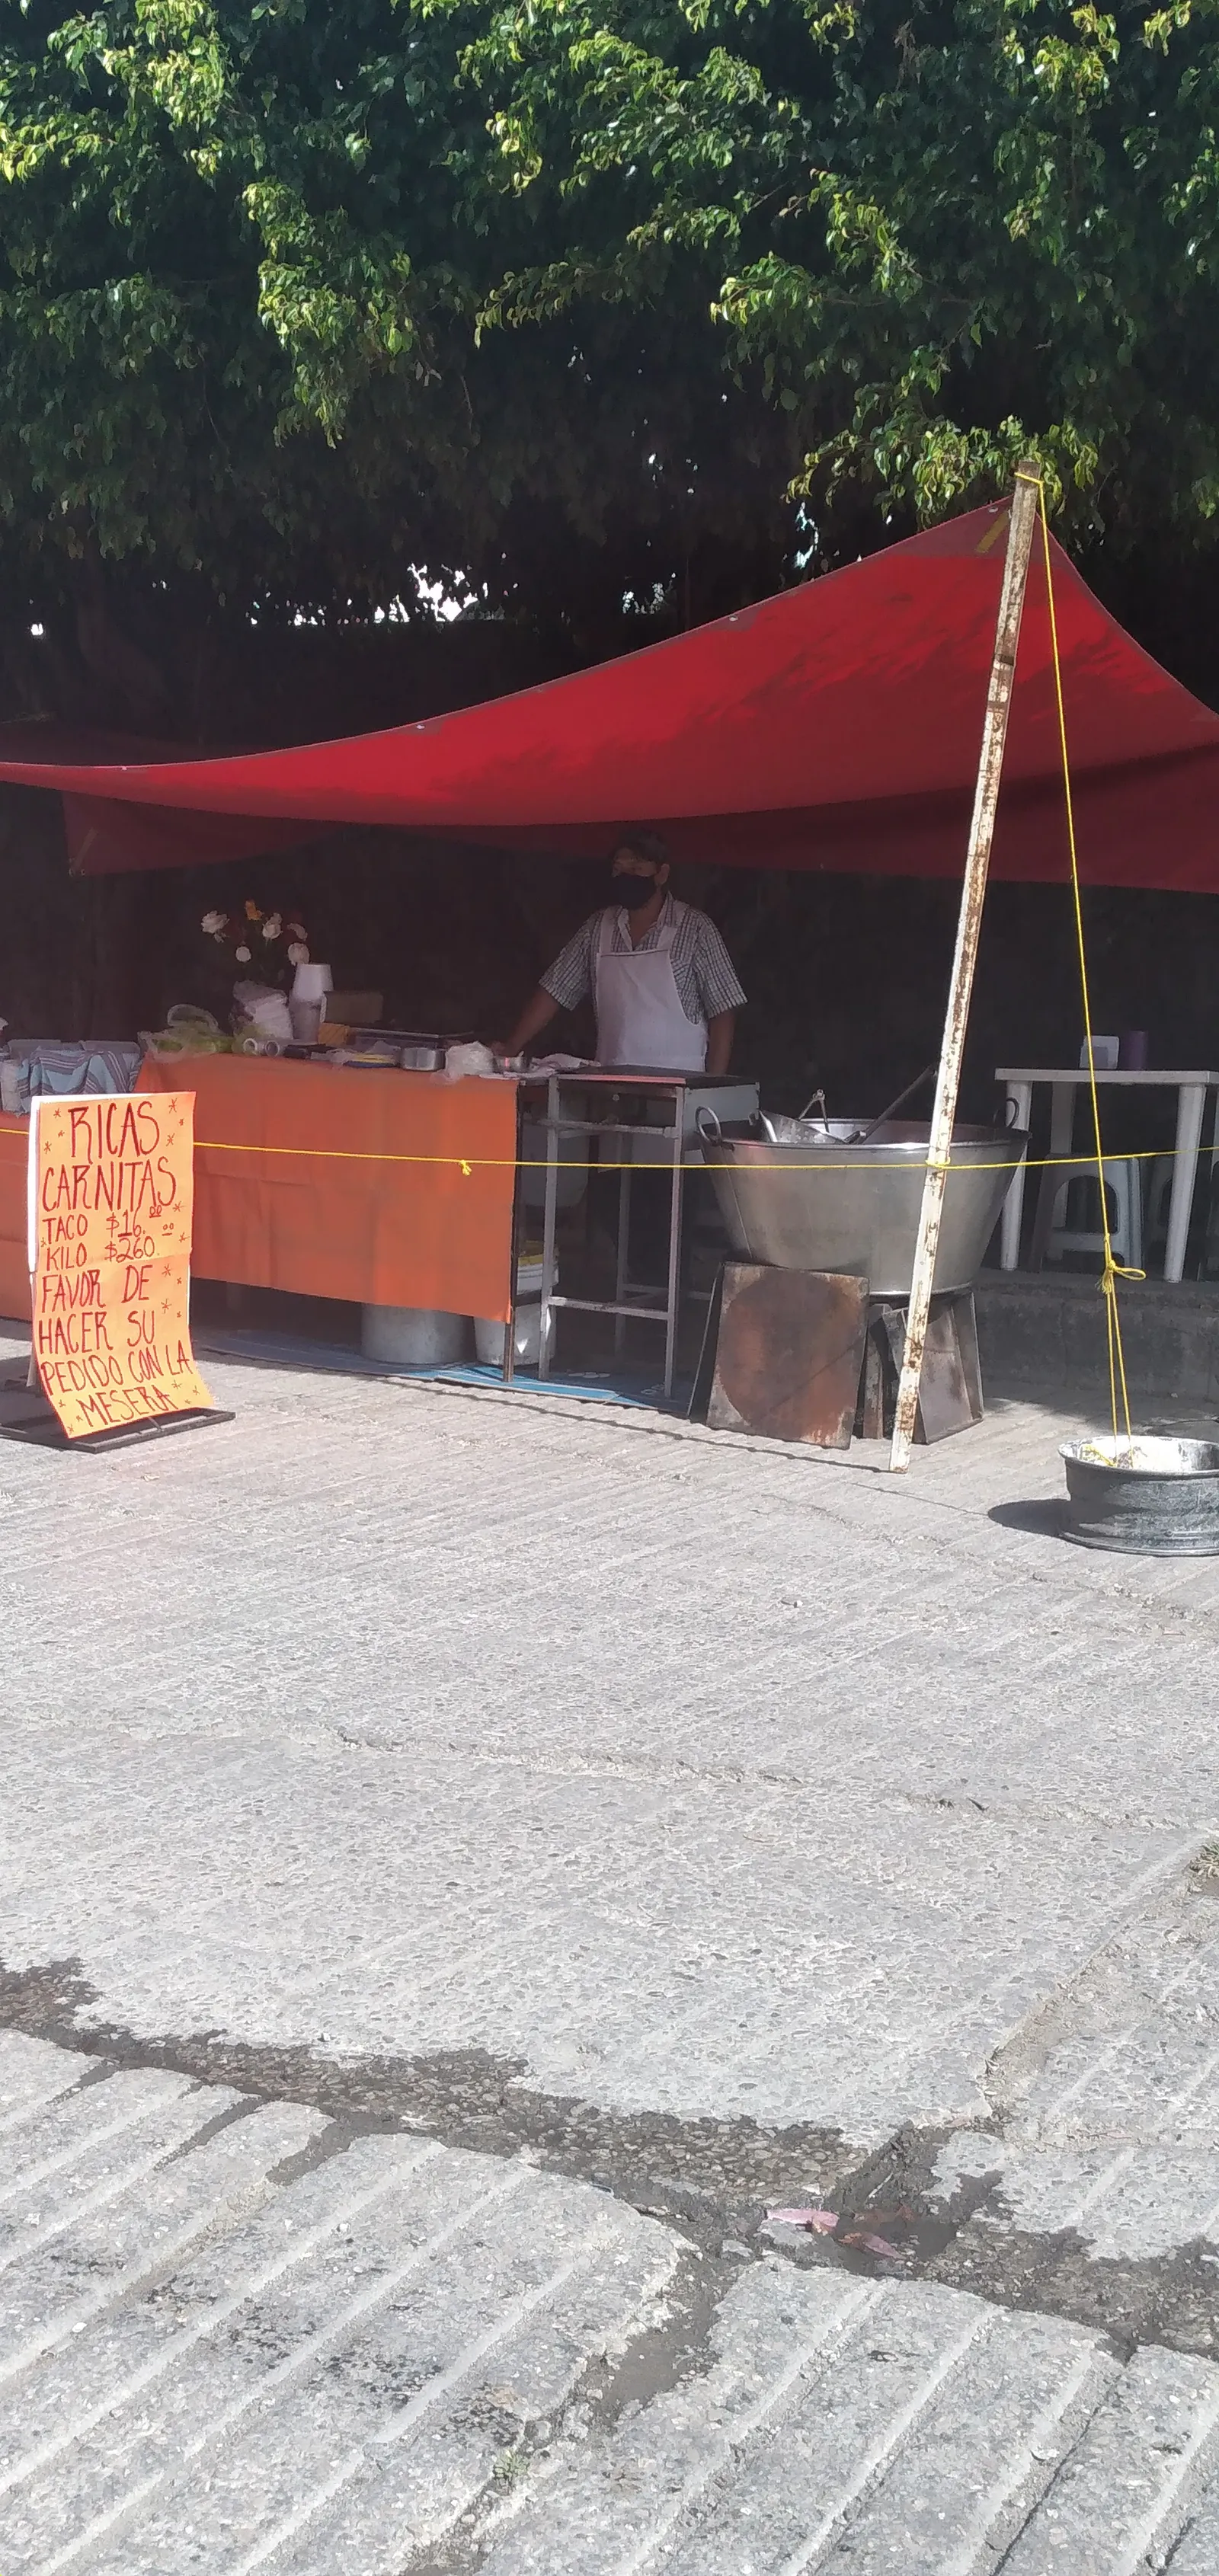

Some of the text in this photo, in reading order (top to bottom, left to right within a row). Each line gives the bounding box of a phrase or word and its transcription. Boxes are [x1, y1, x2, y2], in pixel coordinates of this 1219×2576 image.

[68, 1101, 160, 1163] RICAS
[42, 1156, 177, 1212] CARNITAS
[42, 1214, 88, 1243] TACO
[46, 1242, 87, 1271] KILO
[42, 1265, 154, 1313] FAVOR DE
[39, 1310, 155, 1355] HACER SU
[40, 1340, 194, 1396] PEDIDO CON LA
[76, 1385, 179, 1427] MESERA
